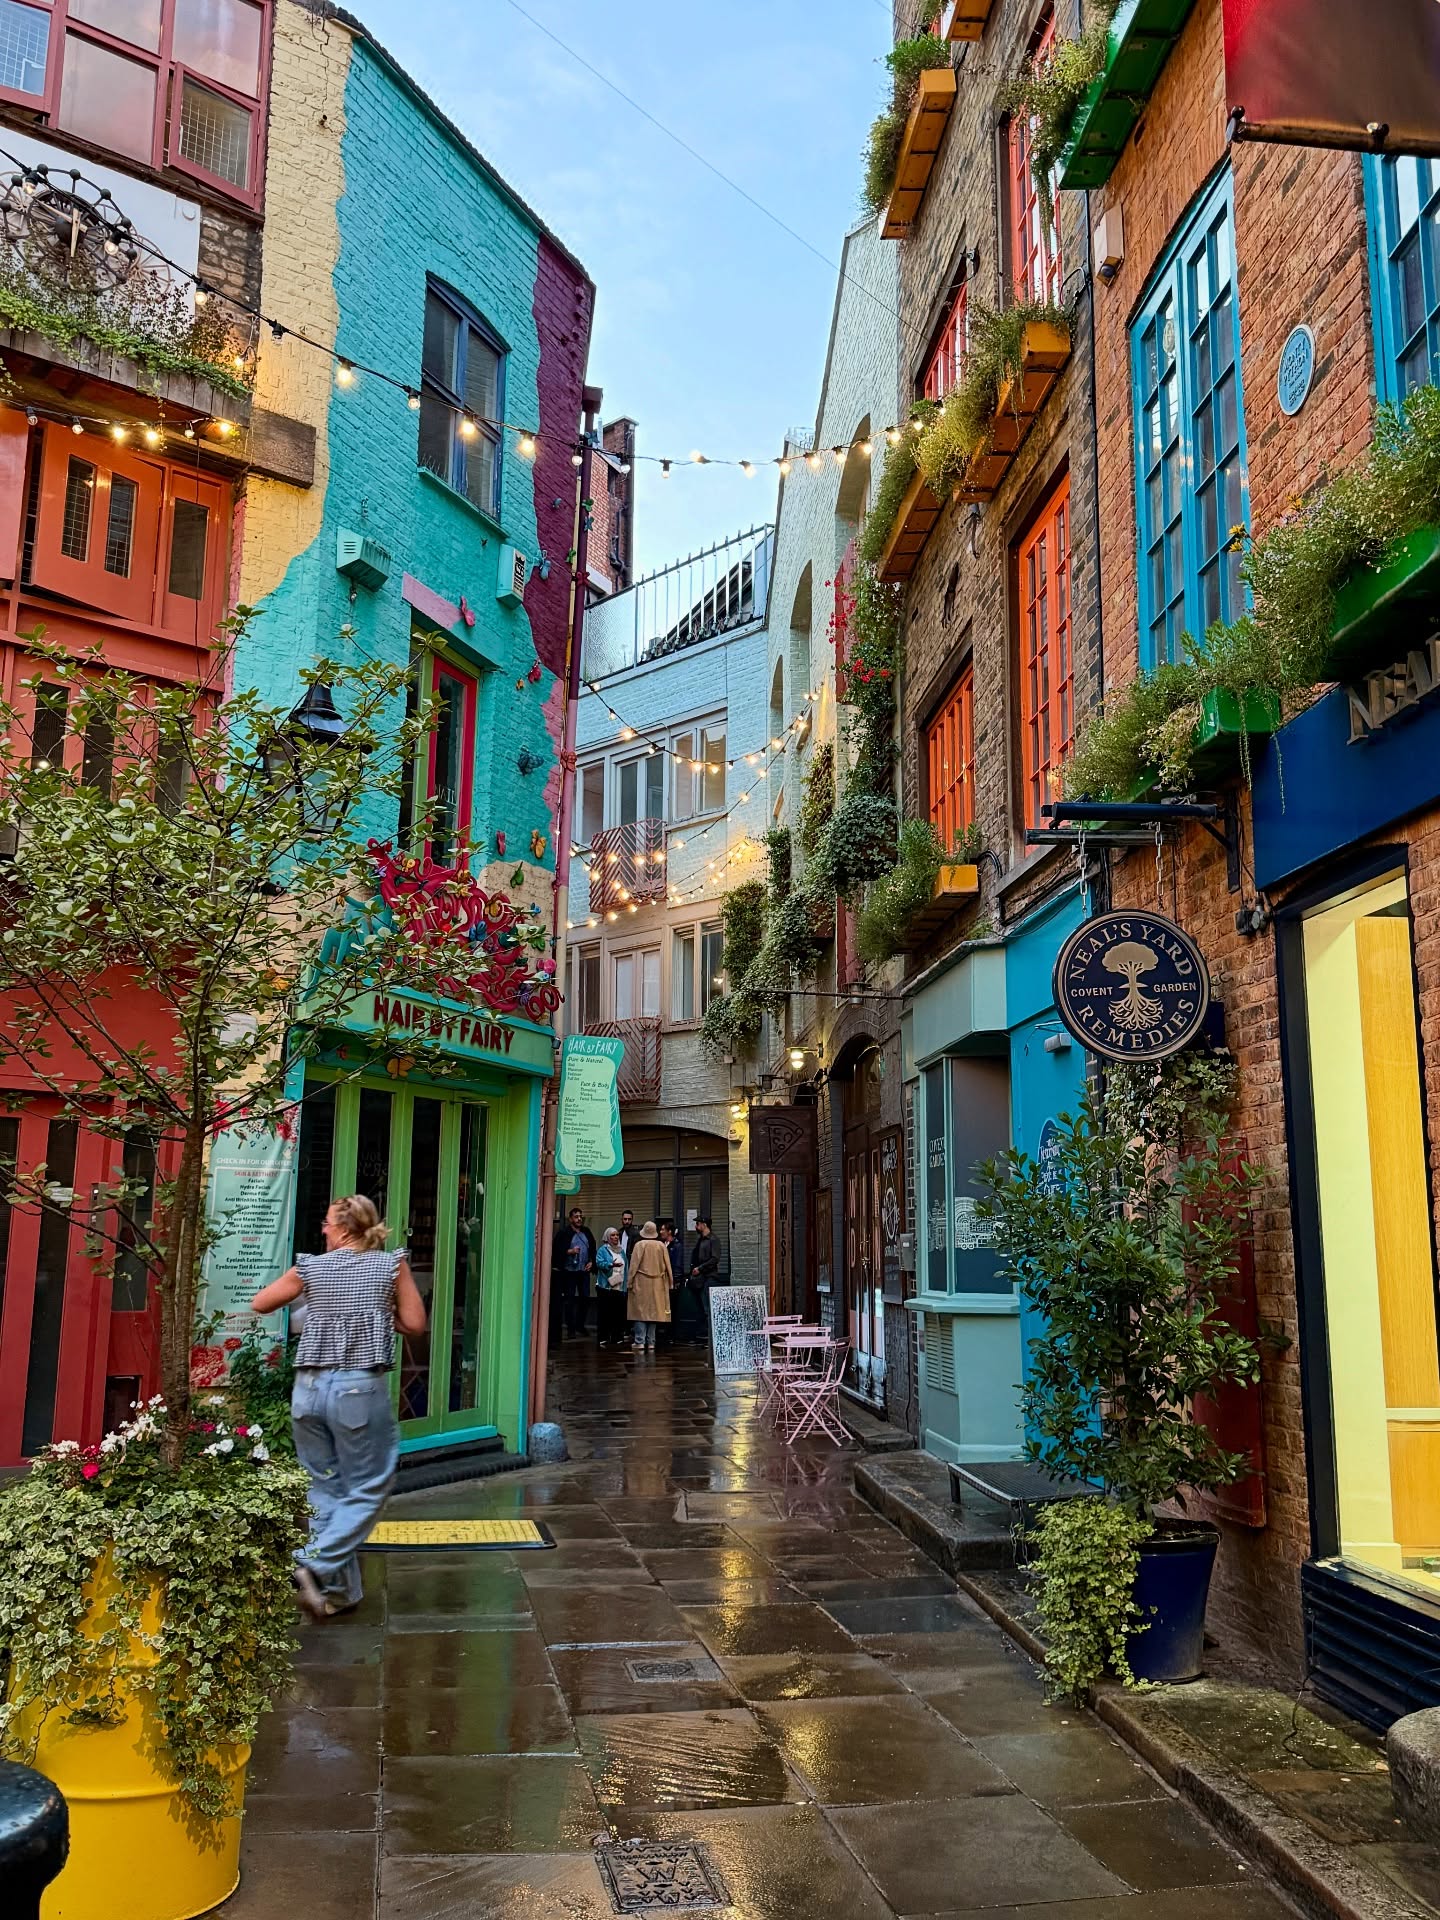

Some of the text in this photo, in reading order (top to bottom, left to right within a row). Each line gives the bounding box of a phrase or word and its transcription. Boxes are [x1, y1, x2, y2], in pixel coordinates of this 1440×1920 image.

[1070, 922, 1192, 982] NEAL'S YARD
[1070, 982, 1196, 998] COVENT GARDEN
[460, 1018, 515, 1054] FAIRY
[1077, 999, 1194, 1049] REMEDIES
[568, 1037, 586, 1052] HAIR
[595, 1040, 618, 1055] FAIRY
